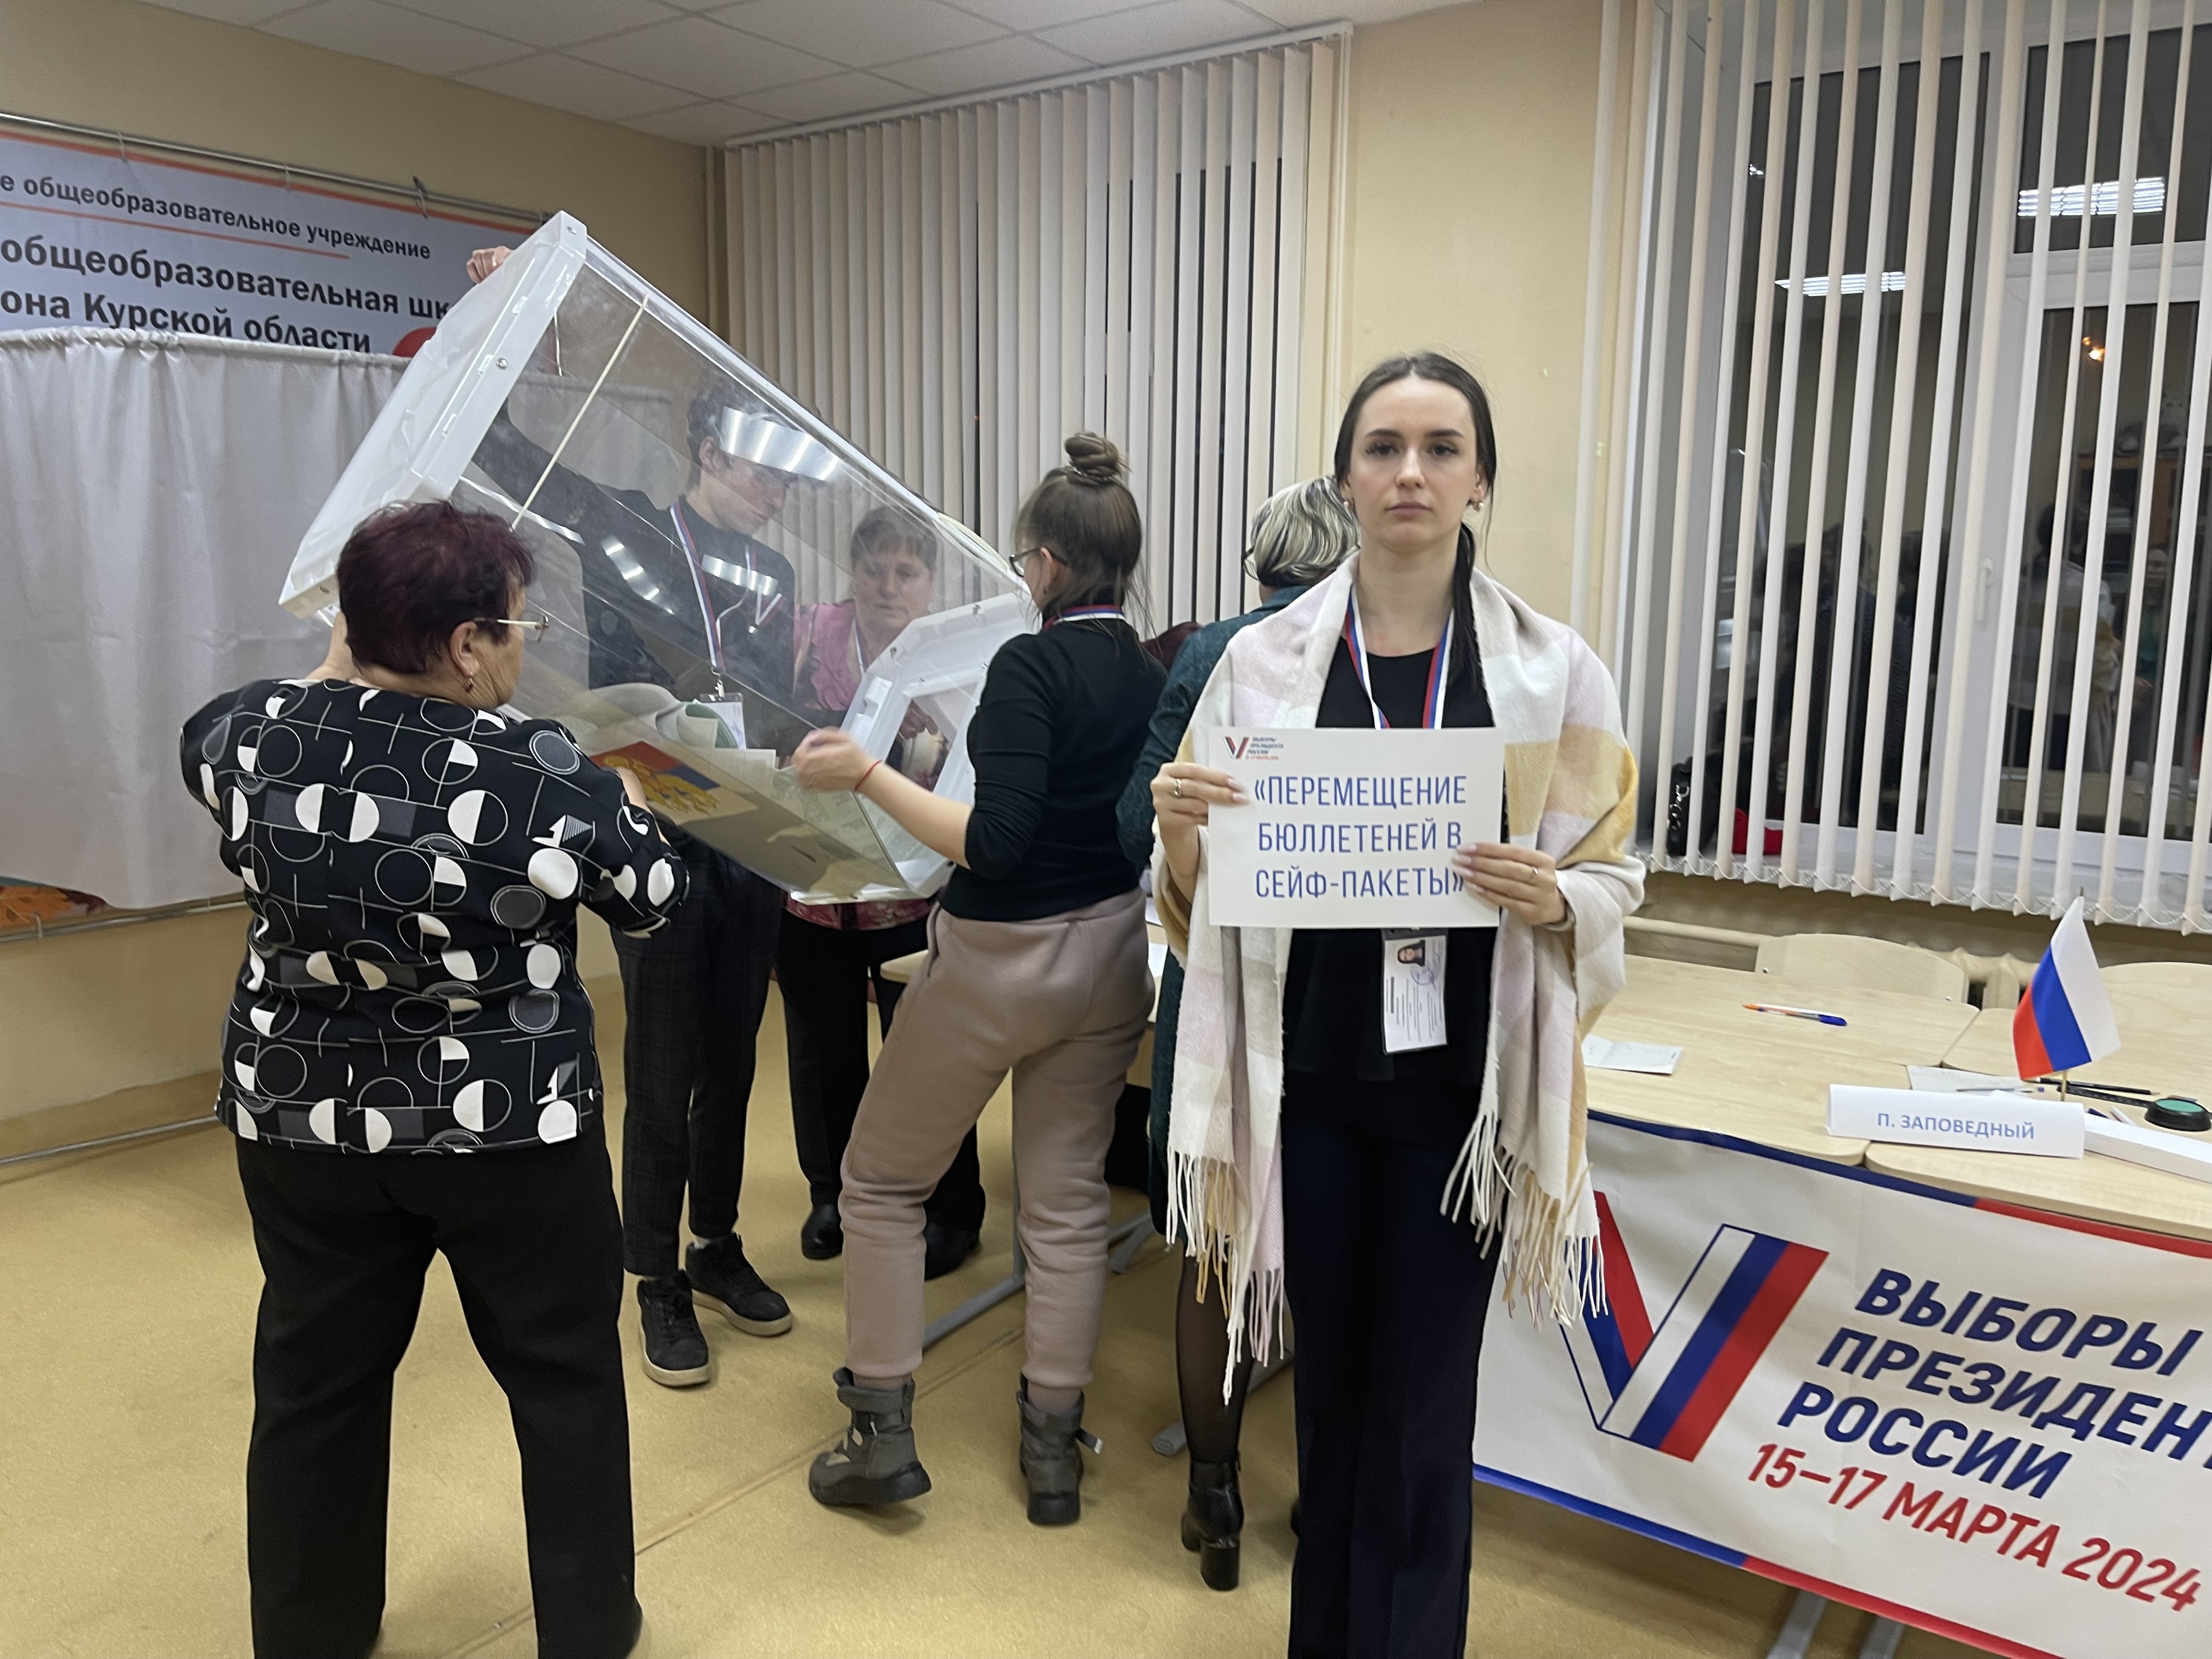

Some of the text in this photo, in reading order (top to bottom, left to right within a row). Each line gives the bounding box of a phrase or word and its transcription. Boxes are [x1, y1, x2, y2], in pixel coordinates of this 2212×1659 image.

[1, 175, 431, 259] е общеобразовательное учреждение
[1, 235, 399, 314] общеобразовательная
[1, 290, 371, 353] она Курской области
[1254, 776, 1467, 809] «ПЕРЕМЕЩЕНИЕ
[1259, 817, 1461, 853] БЮЛЛЕТЕНЕЙ В
[1255, 865, 1464, 898] СЕЙФ-ПАКЕТЫ»
[1877, 1113, 2034, 1139] П. ЗАПОВЕДНЫЙ
[1855, 1268, 2204, 1376] ВЫБОРЫ
[1818, 1327, 2212, 1470] ПРЕЗИДЕН
[1778, 1381, 2073, 1499] РОССИИ
[1882, 1481, 2063, 1568] МАРТА
[2061, 1537, 2203, 1612] 2024
